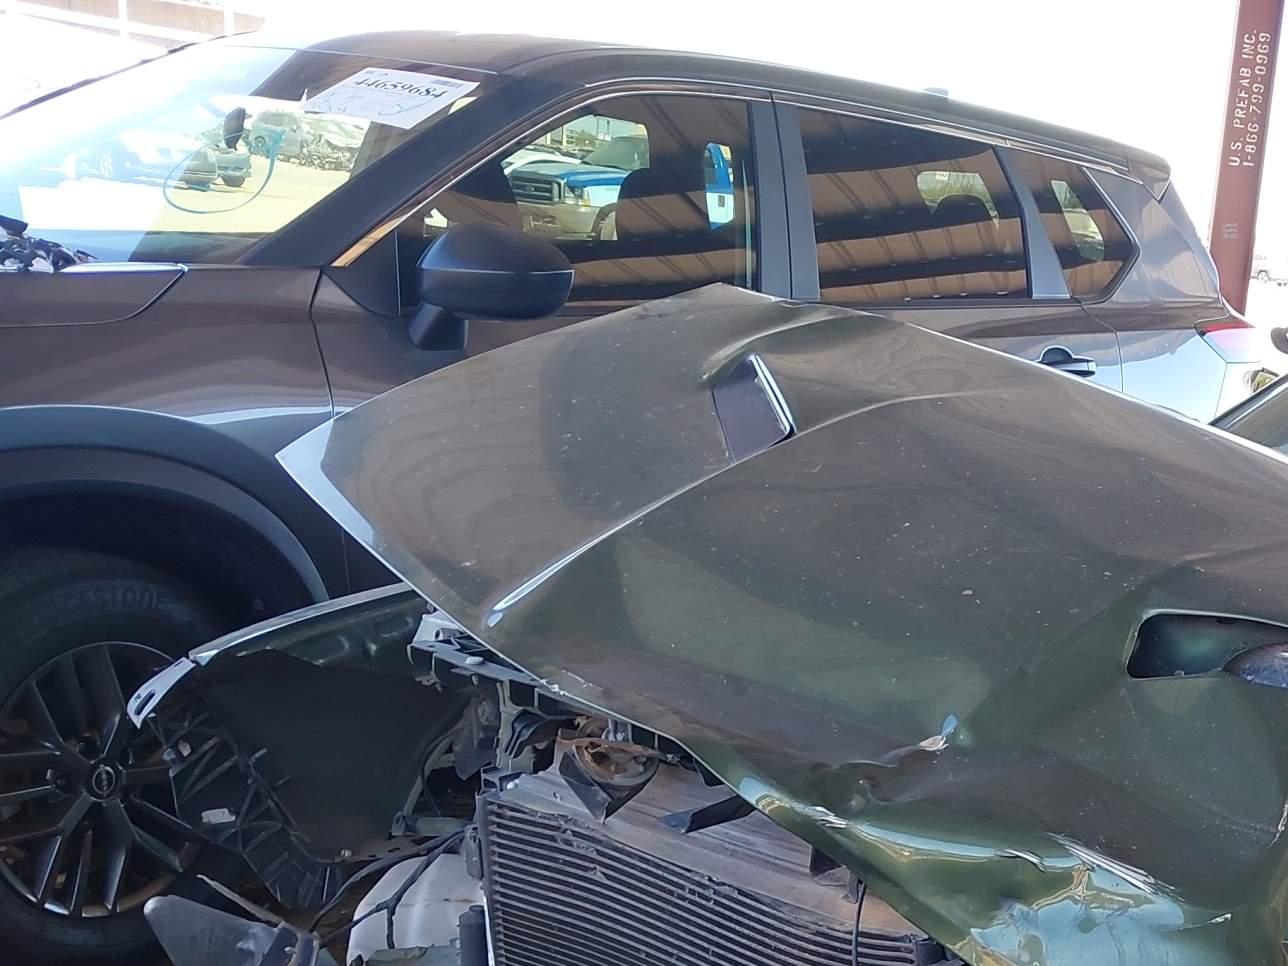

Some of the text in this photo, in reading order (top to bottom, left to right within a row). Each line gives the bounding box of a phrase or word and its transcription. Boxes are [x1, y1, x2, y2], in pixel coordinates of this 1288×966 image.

[353, 77, 449, 99] 44659684
[1228, 30, 1257, 167] U.S. PREFAB INC.
[1242, 32, 1272, 167] 1-866-799-0969
